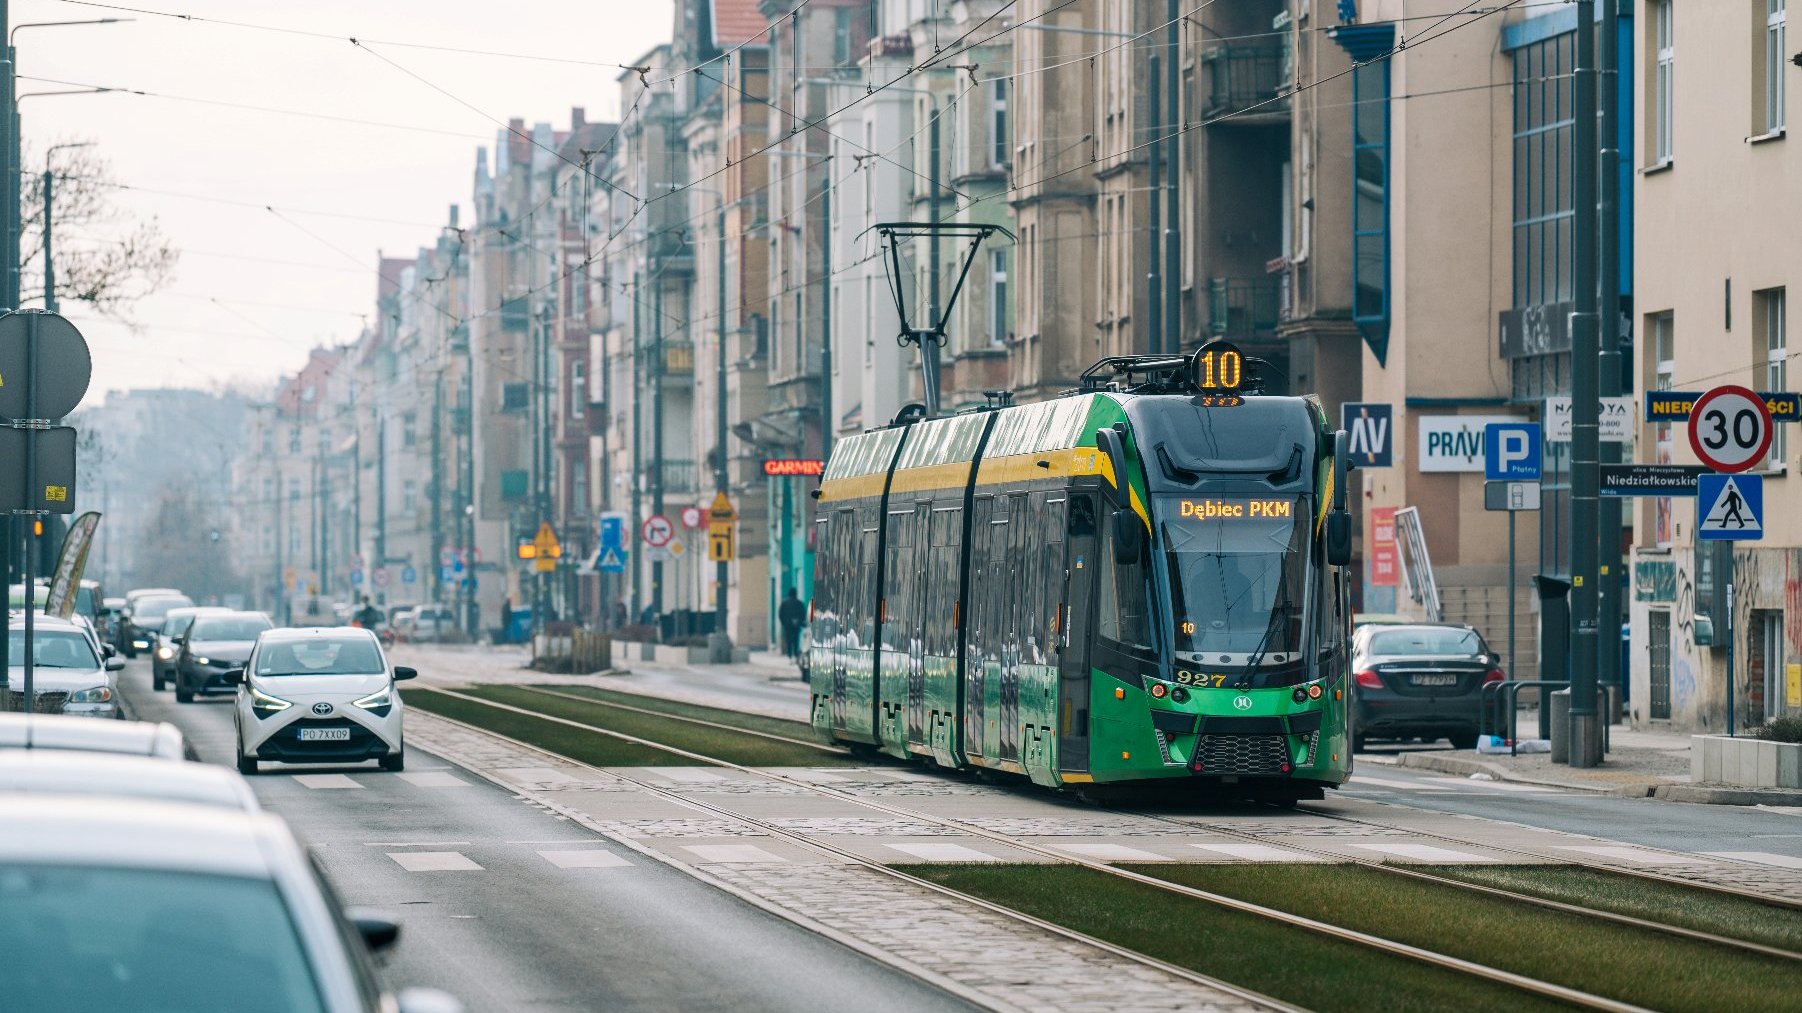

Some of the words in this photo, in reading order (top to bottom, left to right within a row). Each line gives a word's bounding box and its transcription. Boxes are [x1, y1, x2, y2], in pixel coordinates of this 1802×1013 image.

[1201, 350, 1241, 388] 10
[1653, 398, 1794, 414] NIERŚCI
[1703, 408, 1759, 450] 30
[1498, 429, 1530, 473] P
[764, 460, 824, 476] GARMIN
[1512, 464, 1537, 475] Płatny
[1606, 474, 1697, 486] Niedziałkowskie
[1180, 499, 1243, 519] Dębiec
[1249, 500, 1290, 517] PKM
[1181, 622, 1195, 634] 10
[1177, 670, 1227, 688] 927
[319, 730, 348, 739] 7XX09
